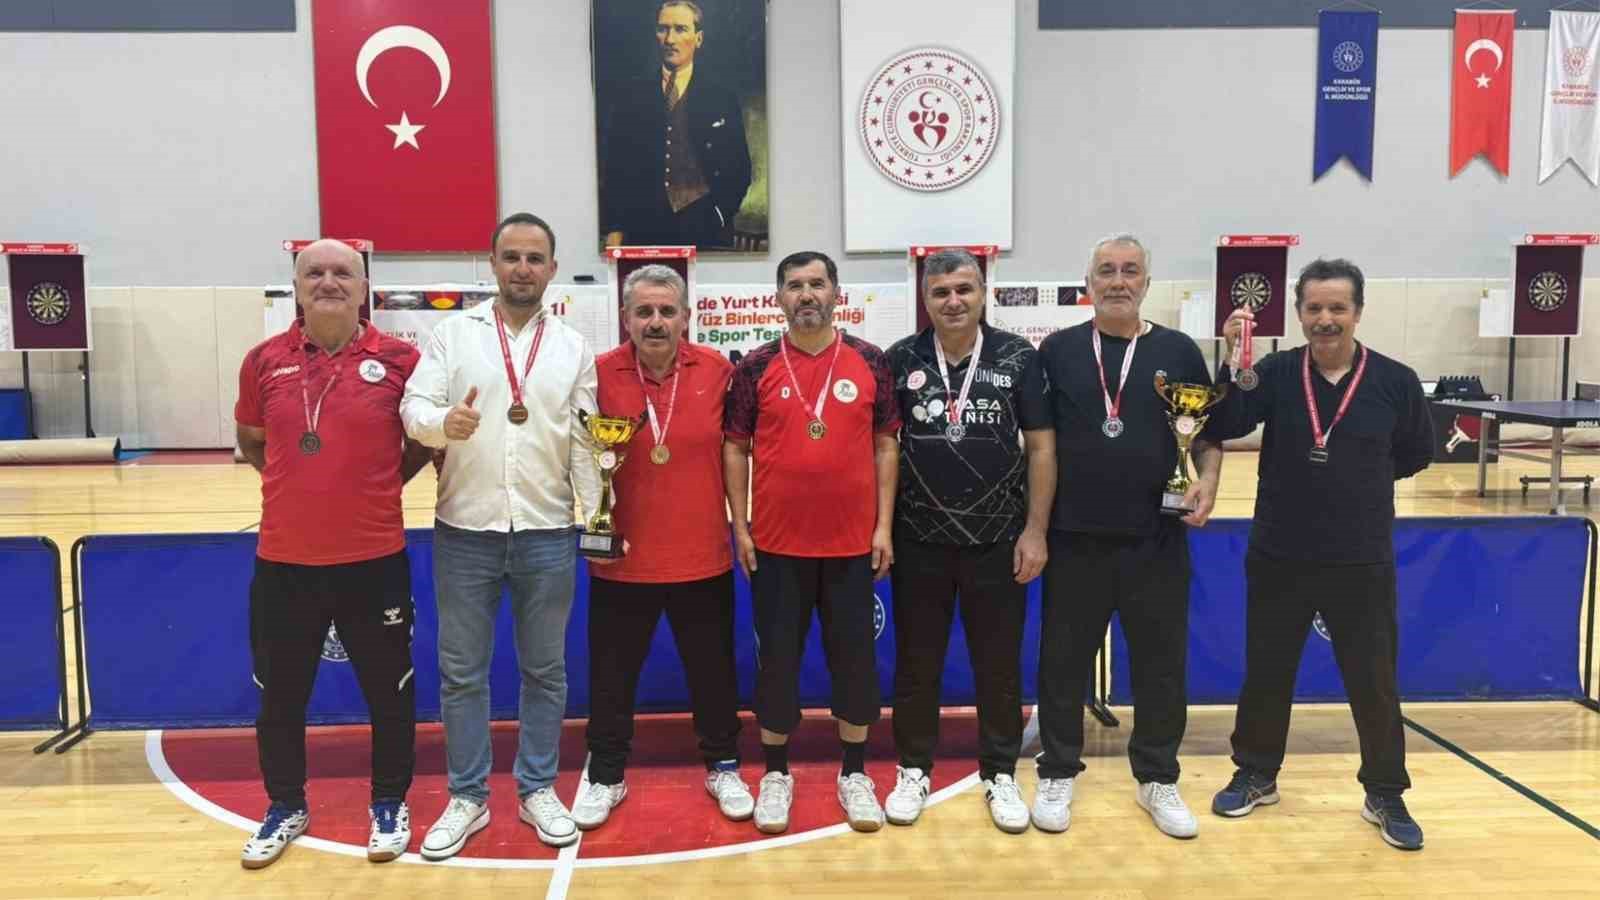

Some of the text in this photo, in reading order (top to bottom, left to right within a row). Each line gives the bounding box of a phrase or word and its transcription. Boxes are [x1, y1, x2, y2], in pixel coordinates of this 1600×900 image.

[721, 295, 758, 310] Yurt
[697, 313, 722, 326] üz
[726, 311, 785, 326] Binlerc
[709, 329, 750, 345] Spor
[944, 411, 1001, 425] TNİSİ
